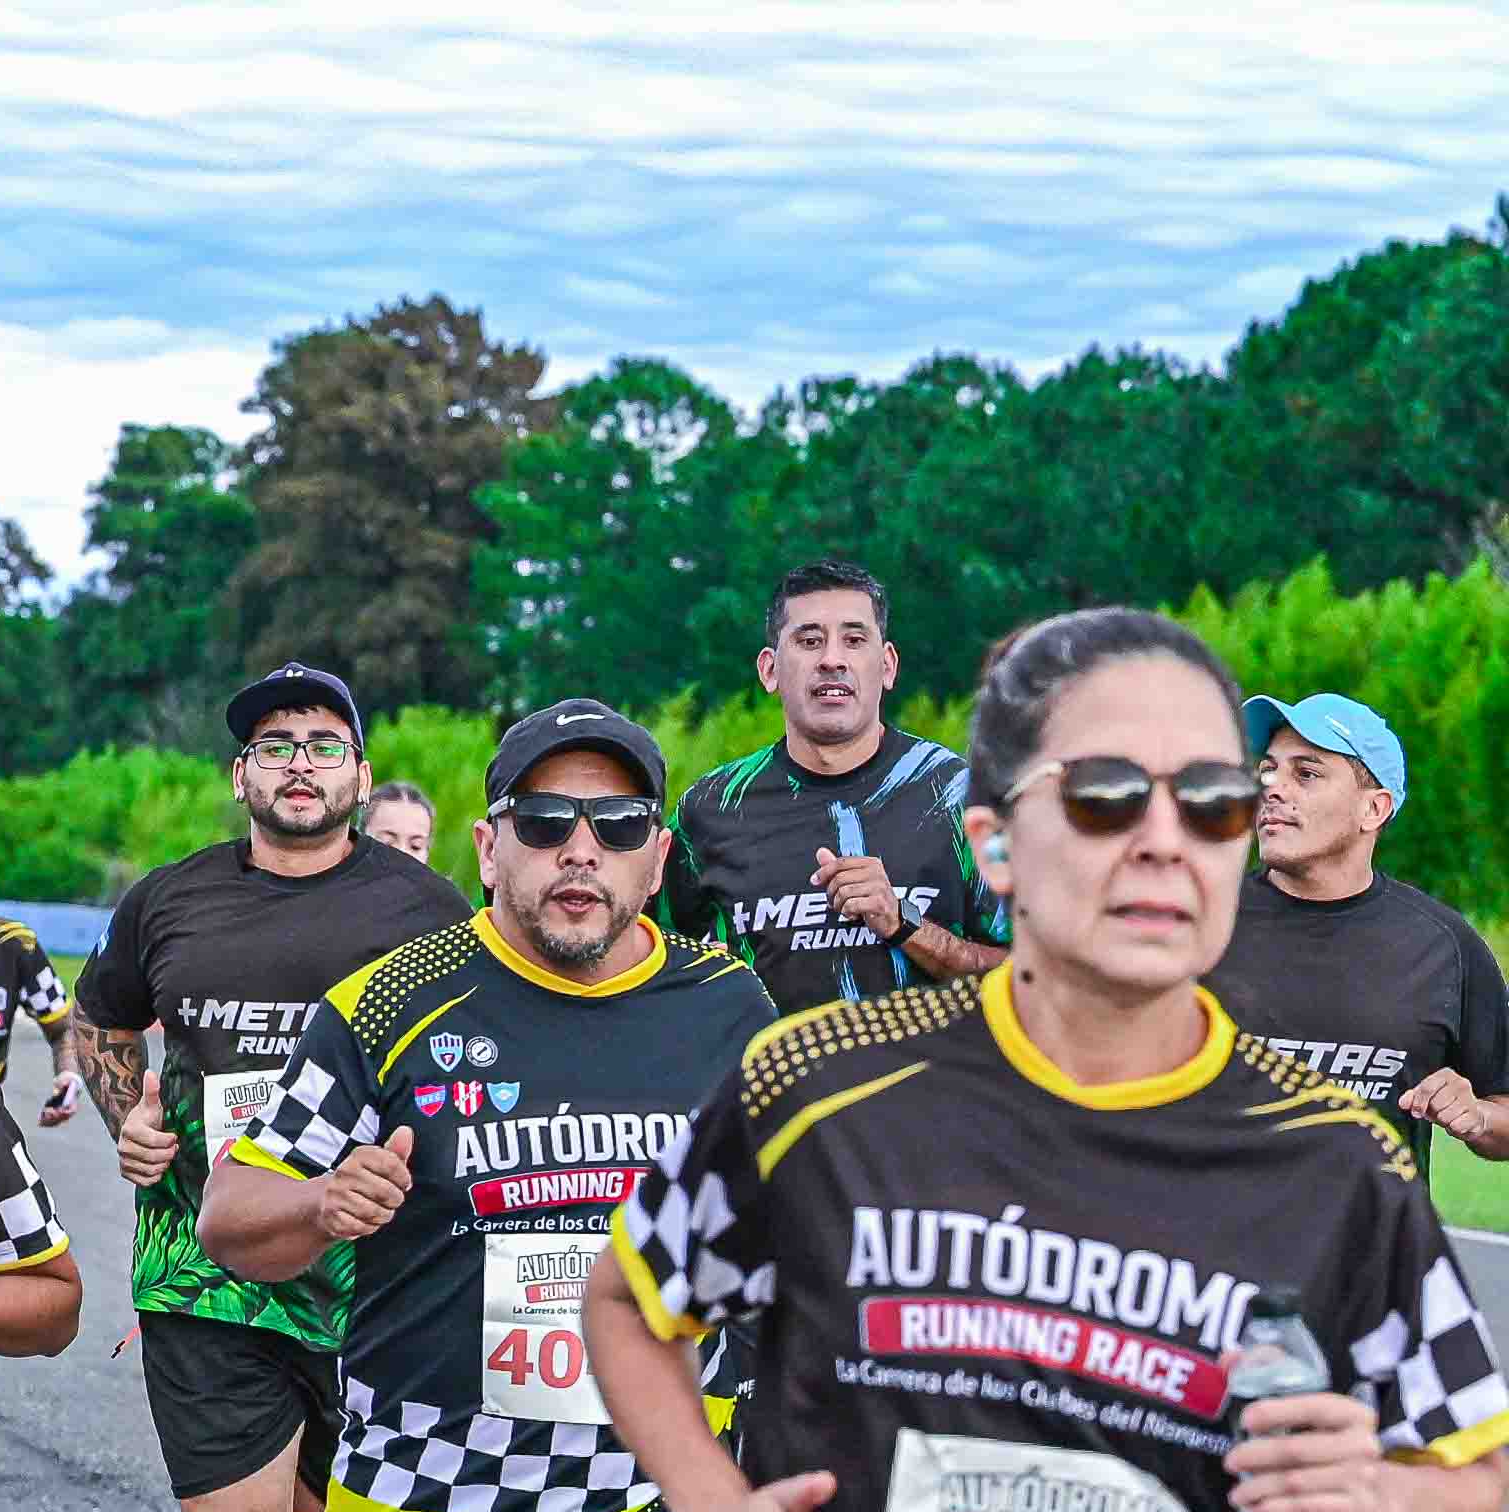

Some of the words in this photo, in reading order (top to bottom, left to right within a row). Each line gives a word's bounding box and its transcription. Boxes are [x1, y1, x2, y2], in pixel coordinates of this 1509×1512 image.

[733, 886, 940, 935] +MES
[791, 927, 881, 950] RUNN
[178, 998, 320, 1031] +MET
[1253, 1035, 1408, 1077] ETAS
[454, 1102, 693, 1178] AUTÓDRO
[501, 1171, 624, 1208] RUNNING
[451, 1220, 468, 1236] La
[473, 1217, 530, 1232] Carrera
[535, 1214, 555, 1230] de
[559, 1214, 584, 1231] los
[588, 1215, 613, 1231] Clu
[517, 1244, 597, 1283] AUTÓD
[513, 1305, 522, 1314] La
[524, 1306, 556, 1315] Carrera
[557, 1305, 568, 1314] de
[487, 1328, 584, 1389] 40
[900, 1303, 1080, 1364] RUNNING
[1084, 1322, 1196, 1402] RACE
